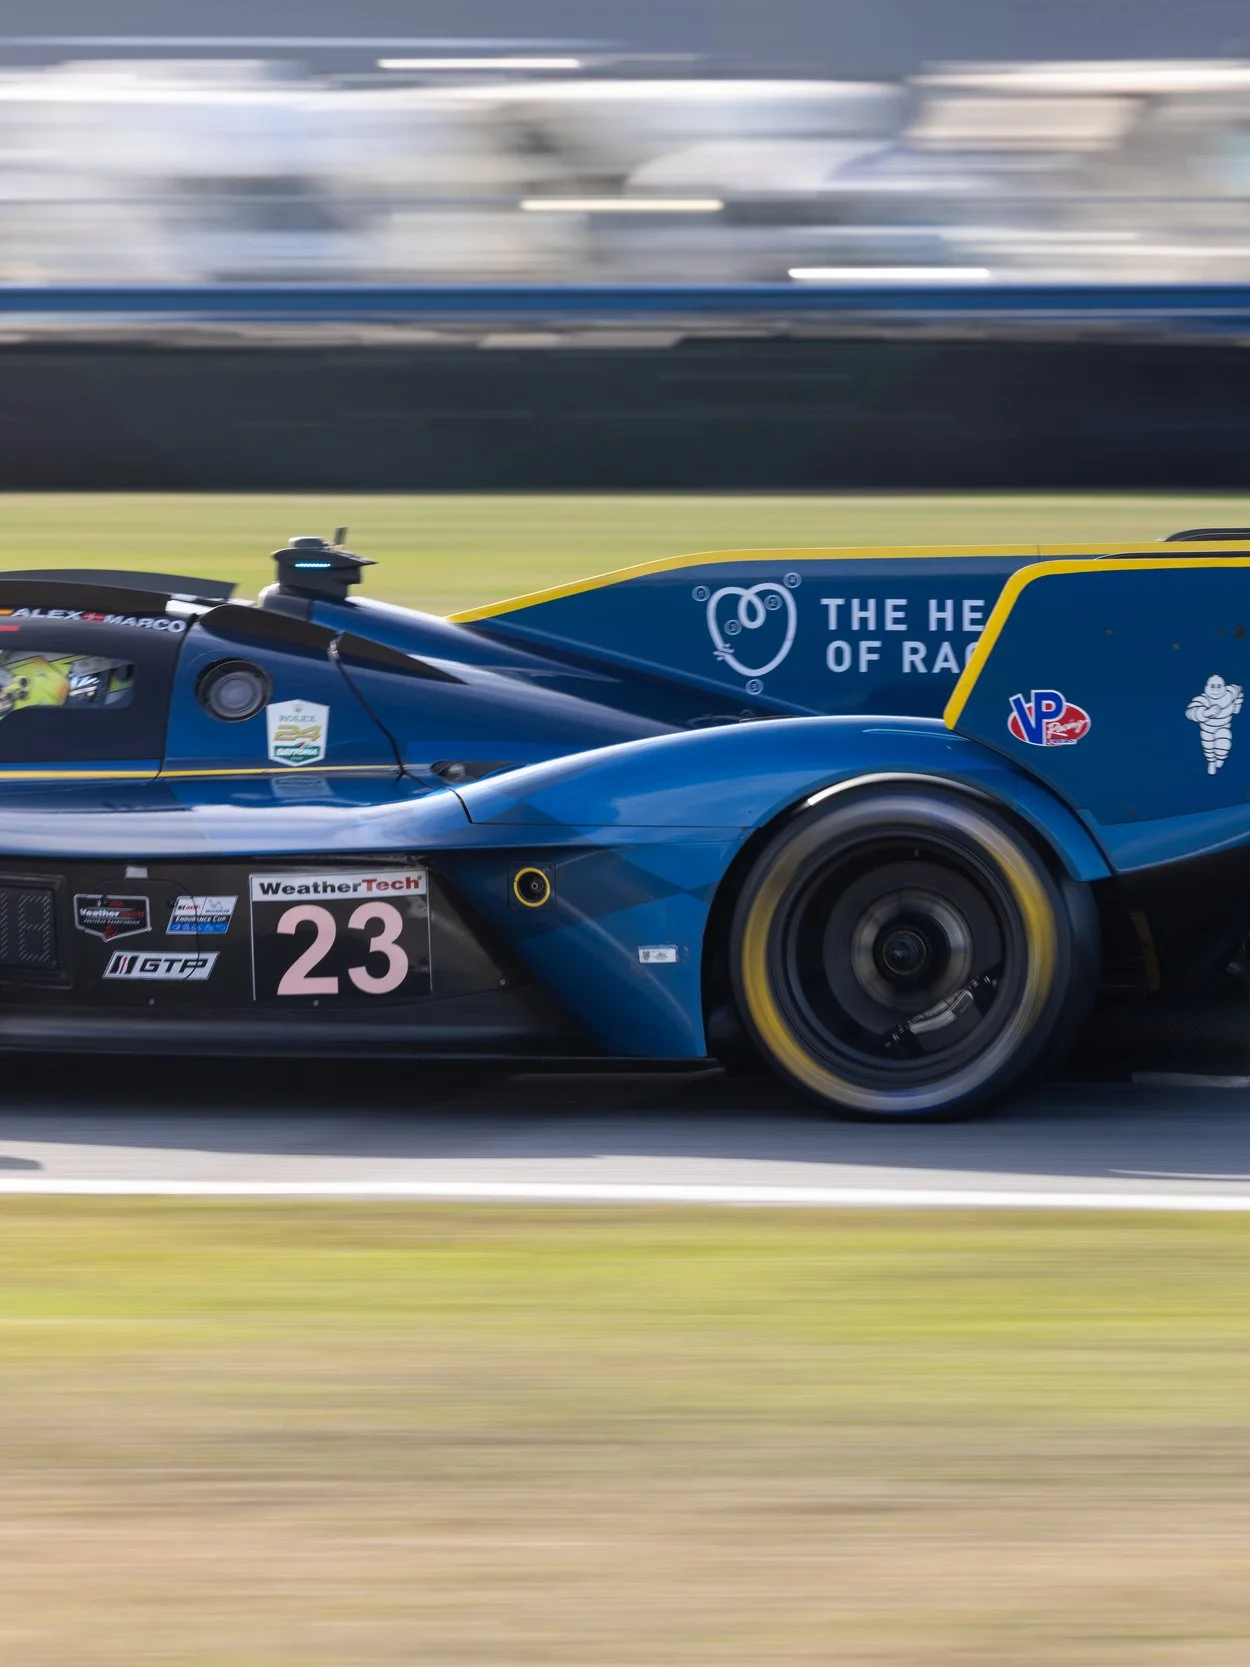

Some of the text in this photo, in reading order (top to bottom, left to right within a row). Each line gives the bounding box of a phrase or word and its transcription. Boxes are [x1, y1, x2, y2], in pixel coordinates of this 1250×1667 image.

[10, 607, 187, 633] ALEX MARCO
[820, 598, 908, 630] THE
[826, 640, 882, 673] OF
[1008, 689, 1066, 746] VP
[273, 725, 321, 741] 24
[259, 876, 420, 895] WeatherTech
[80, 908, 145, 917] Weather
[277, 901, 409, 995] 23
[139, 958, 209, 973] GTP
